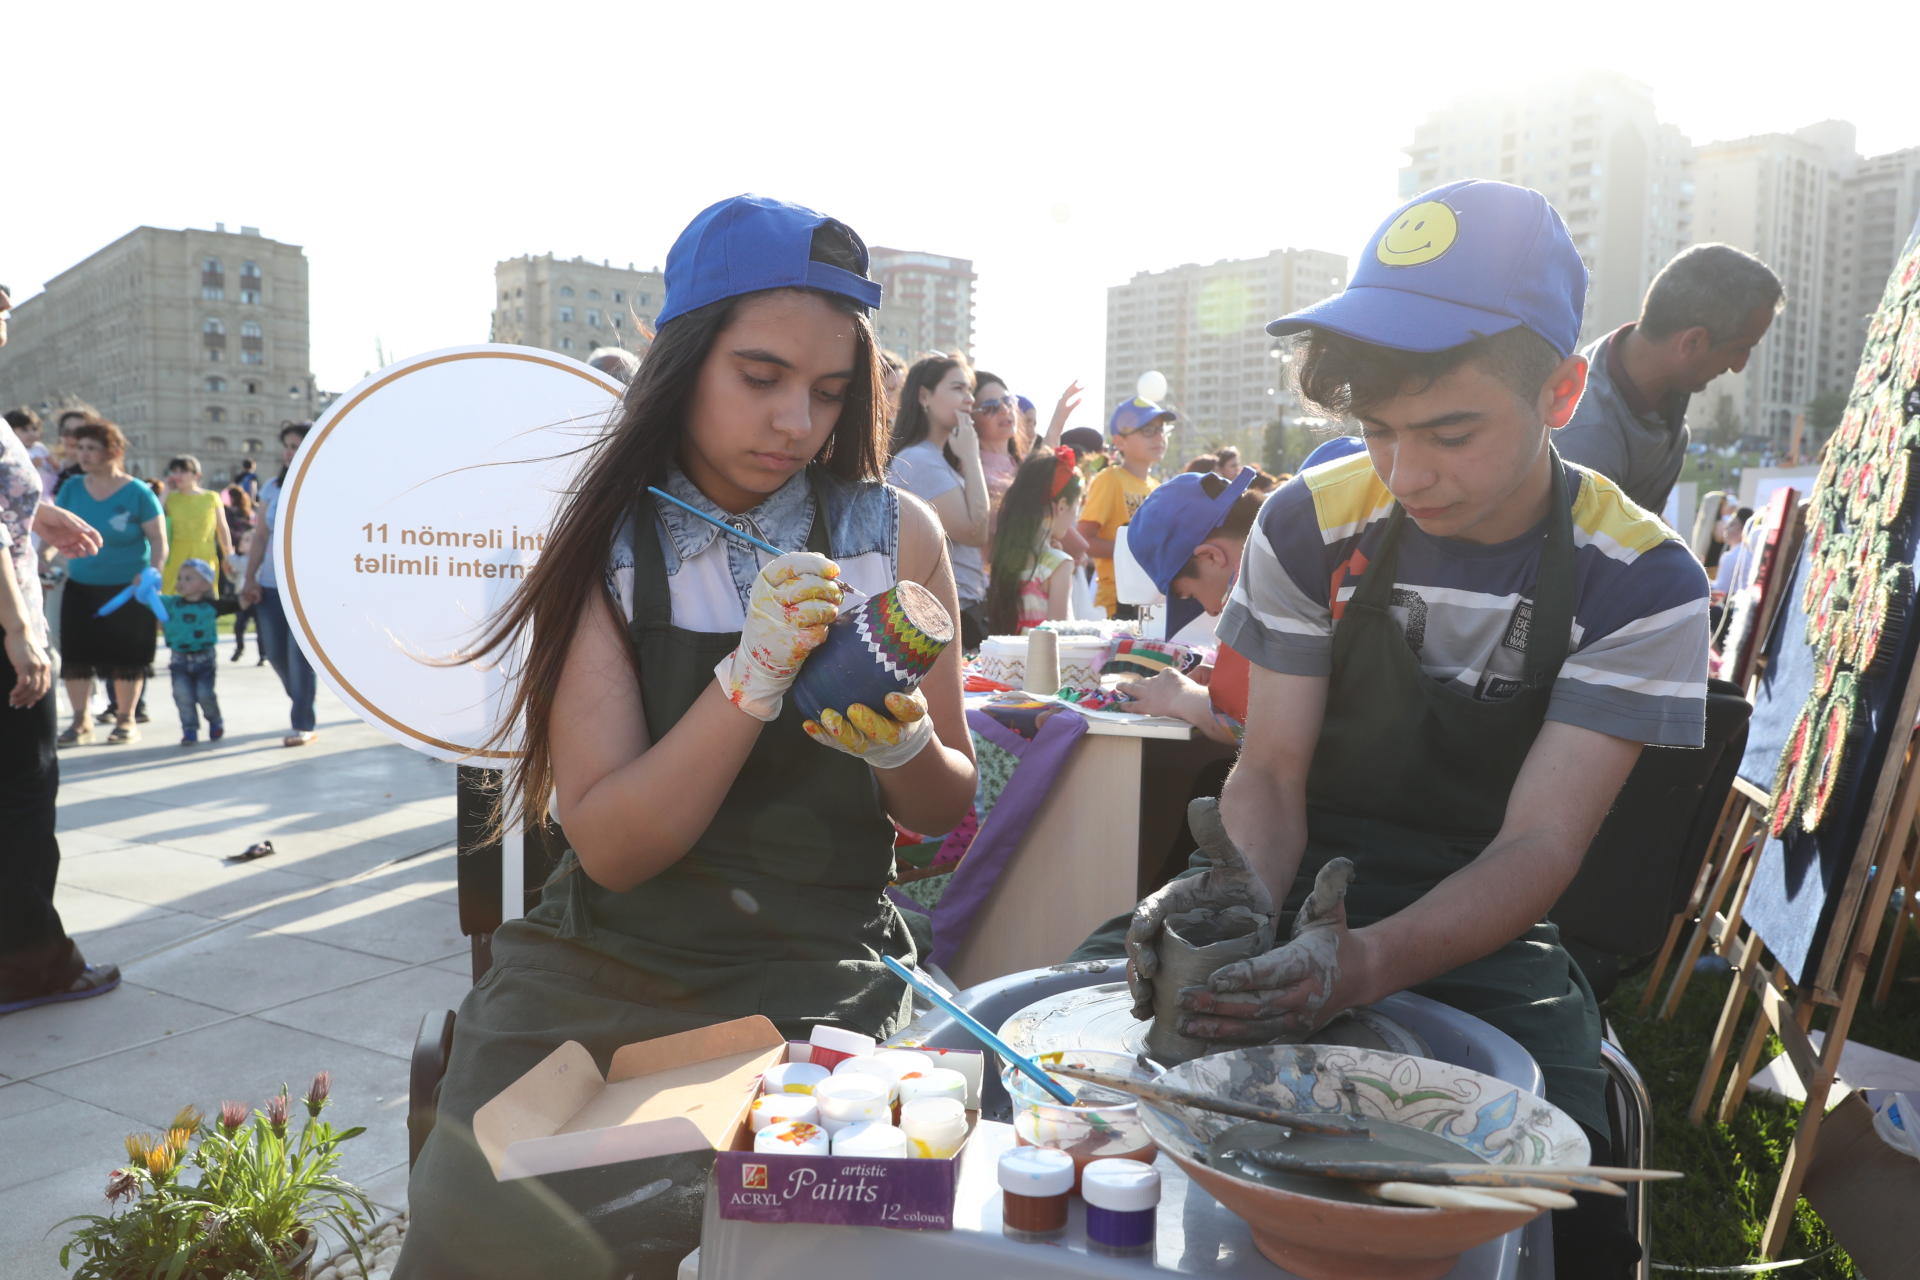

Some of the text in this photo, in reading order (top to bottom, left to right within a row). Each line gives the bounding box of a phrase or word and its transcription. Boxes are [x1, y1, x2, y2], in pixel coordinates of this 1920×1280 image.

[362, 523, 545, 551] 11 nömrəli İnt
[354, 553, 533, 579] təlimli intern
[841, 1164, 887, 1177] artistic
[783, 1168, 879, 1202] Paints
[731, 1193, 782, 1206] ACRYL
[880, 1203, 945, 1224] 12 colours
